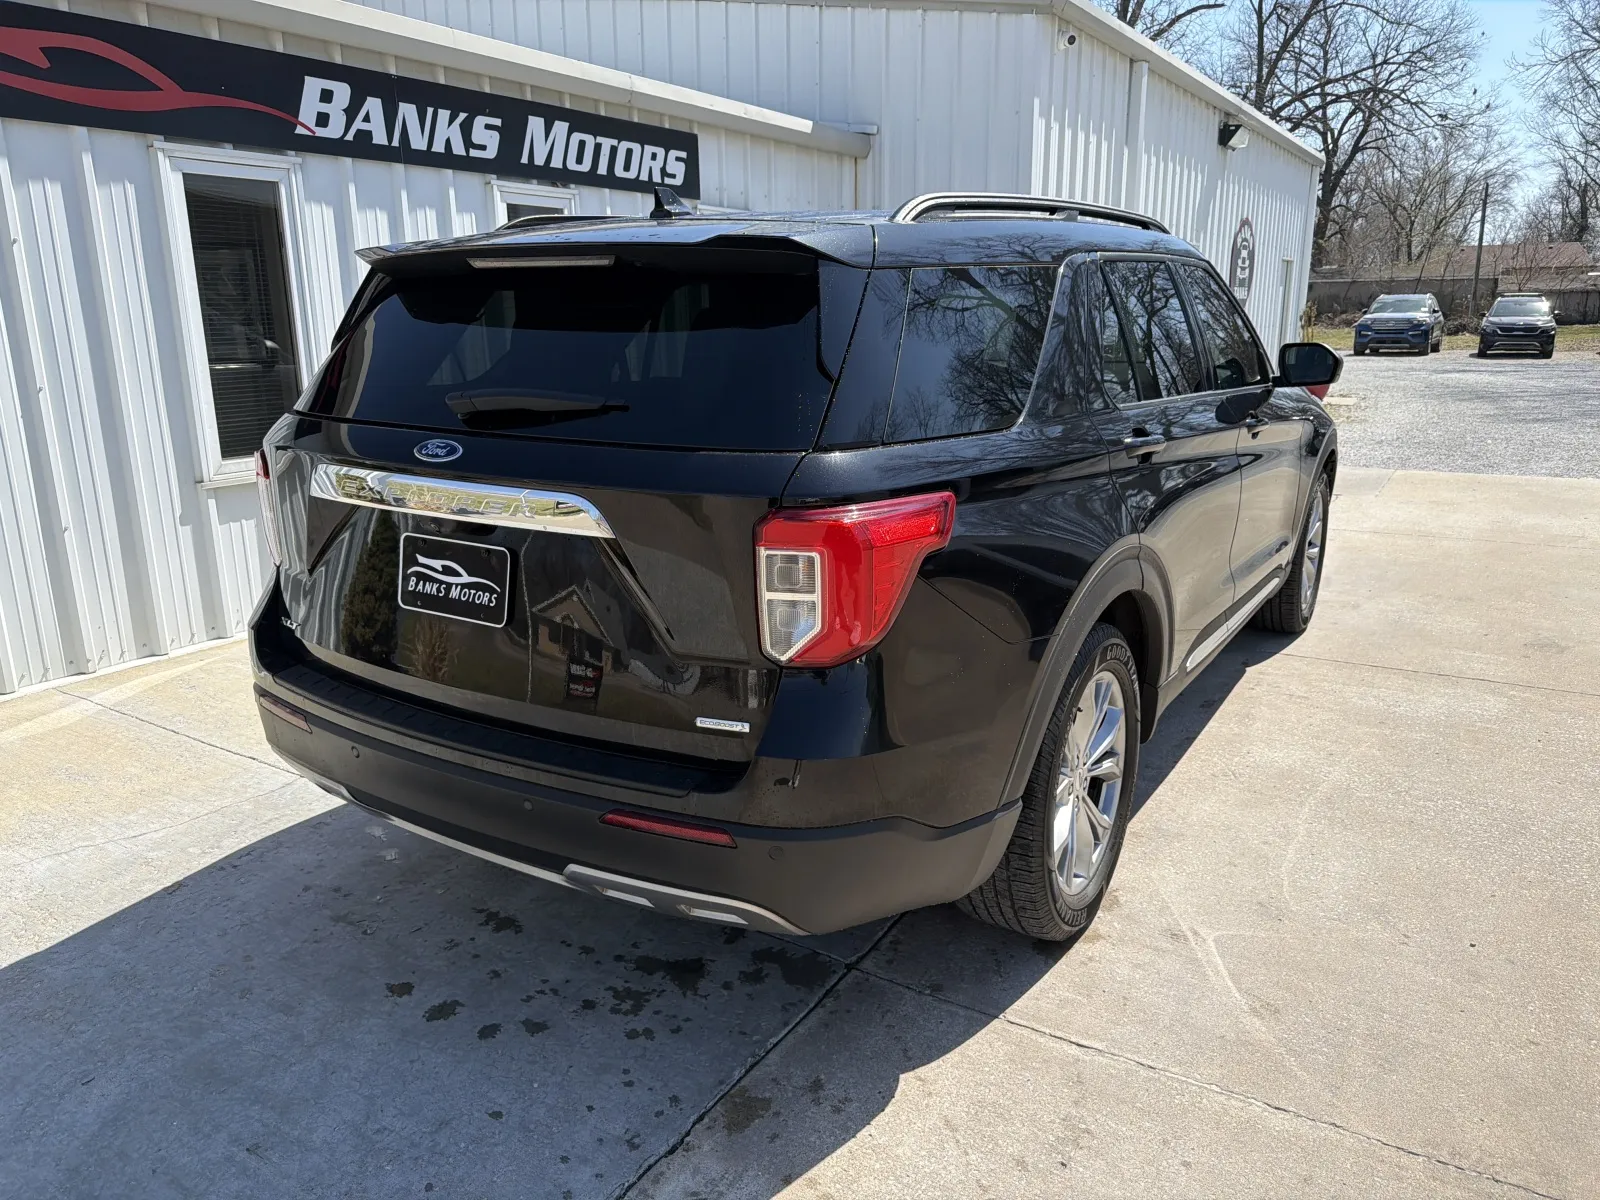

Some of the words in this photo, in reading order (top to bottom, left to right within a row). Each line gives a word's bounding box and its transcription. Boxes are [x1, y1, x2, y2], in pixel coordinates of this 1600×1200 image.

[295, 75, 502, 160] BANKS
[519, 115, 688, 186] MOTORS
[421, 442, 451, 456] Ford
[339, 479, 536, 519] EXPLORER
[407, 576, 446, 597] BANKS
[449, 584, 498, 607] MOTORS
